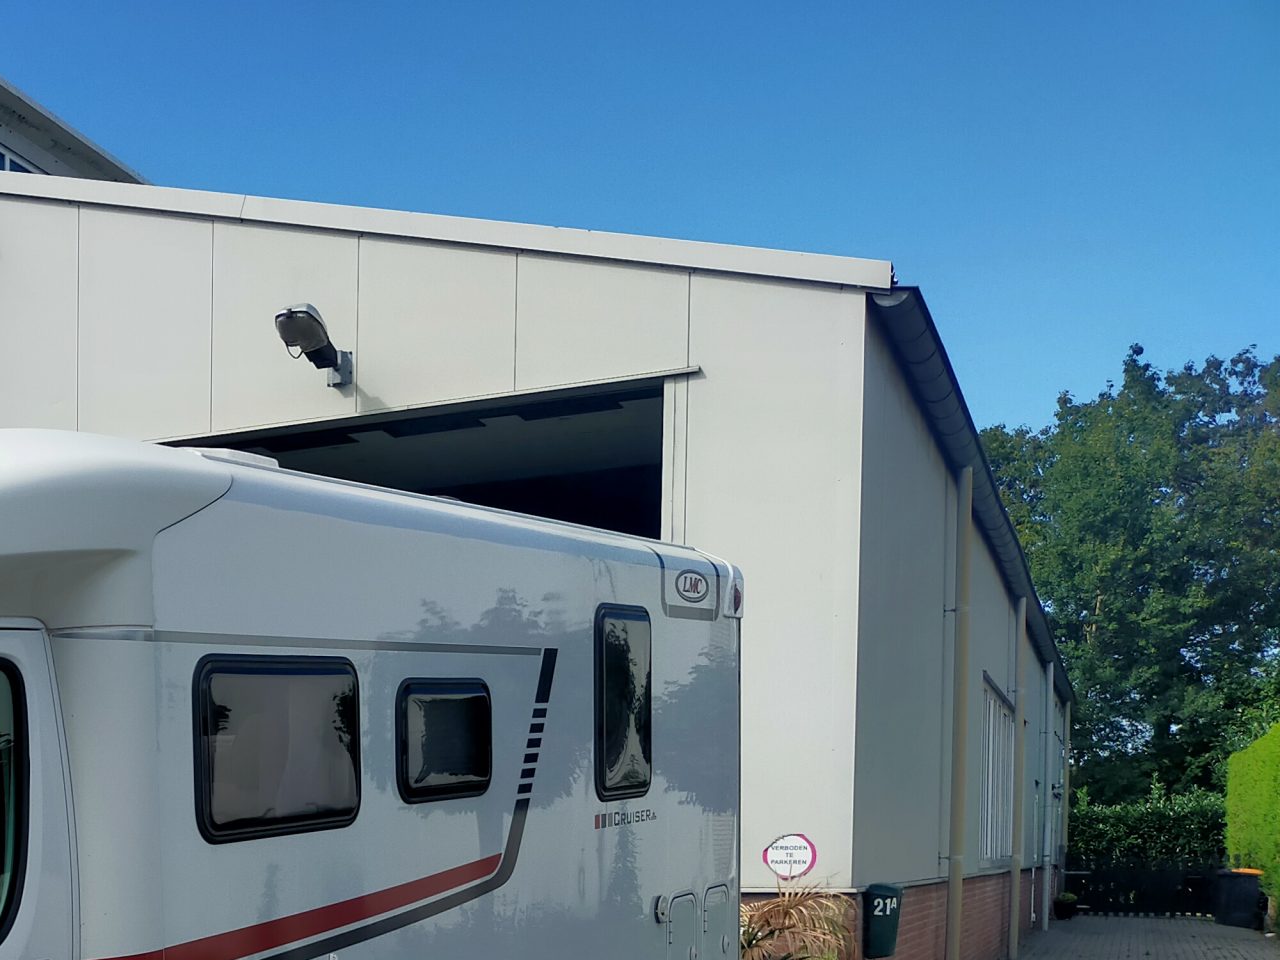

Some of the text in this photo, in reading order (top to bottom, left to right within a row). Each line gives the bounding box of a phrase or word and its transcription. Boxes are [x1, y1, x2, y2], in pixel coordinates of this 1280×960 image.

[683, 576, 703, 595] LMC
[614, 809, 651, 826] CRUISER
[873, 897, 897, 916] 21A
